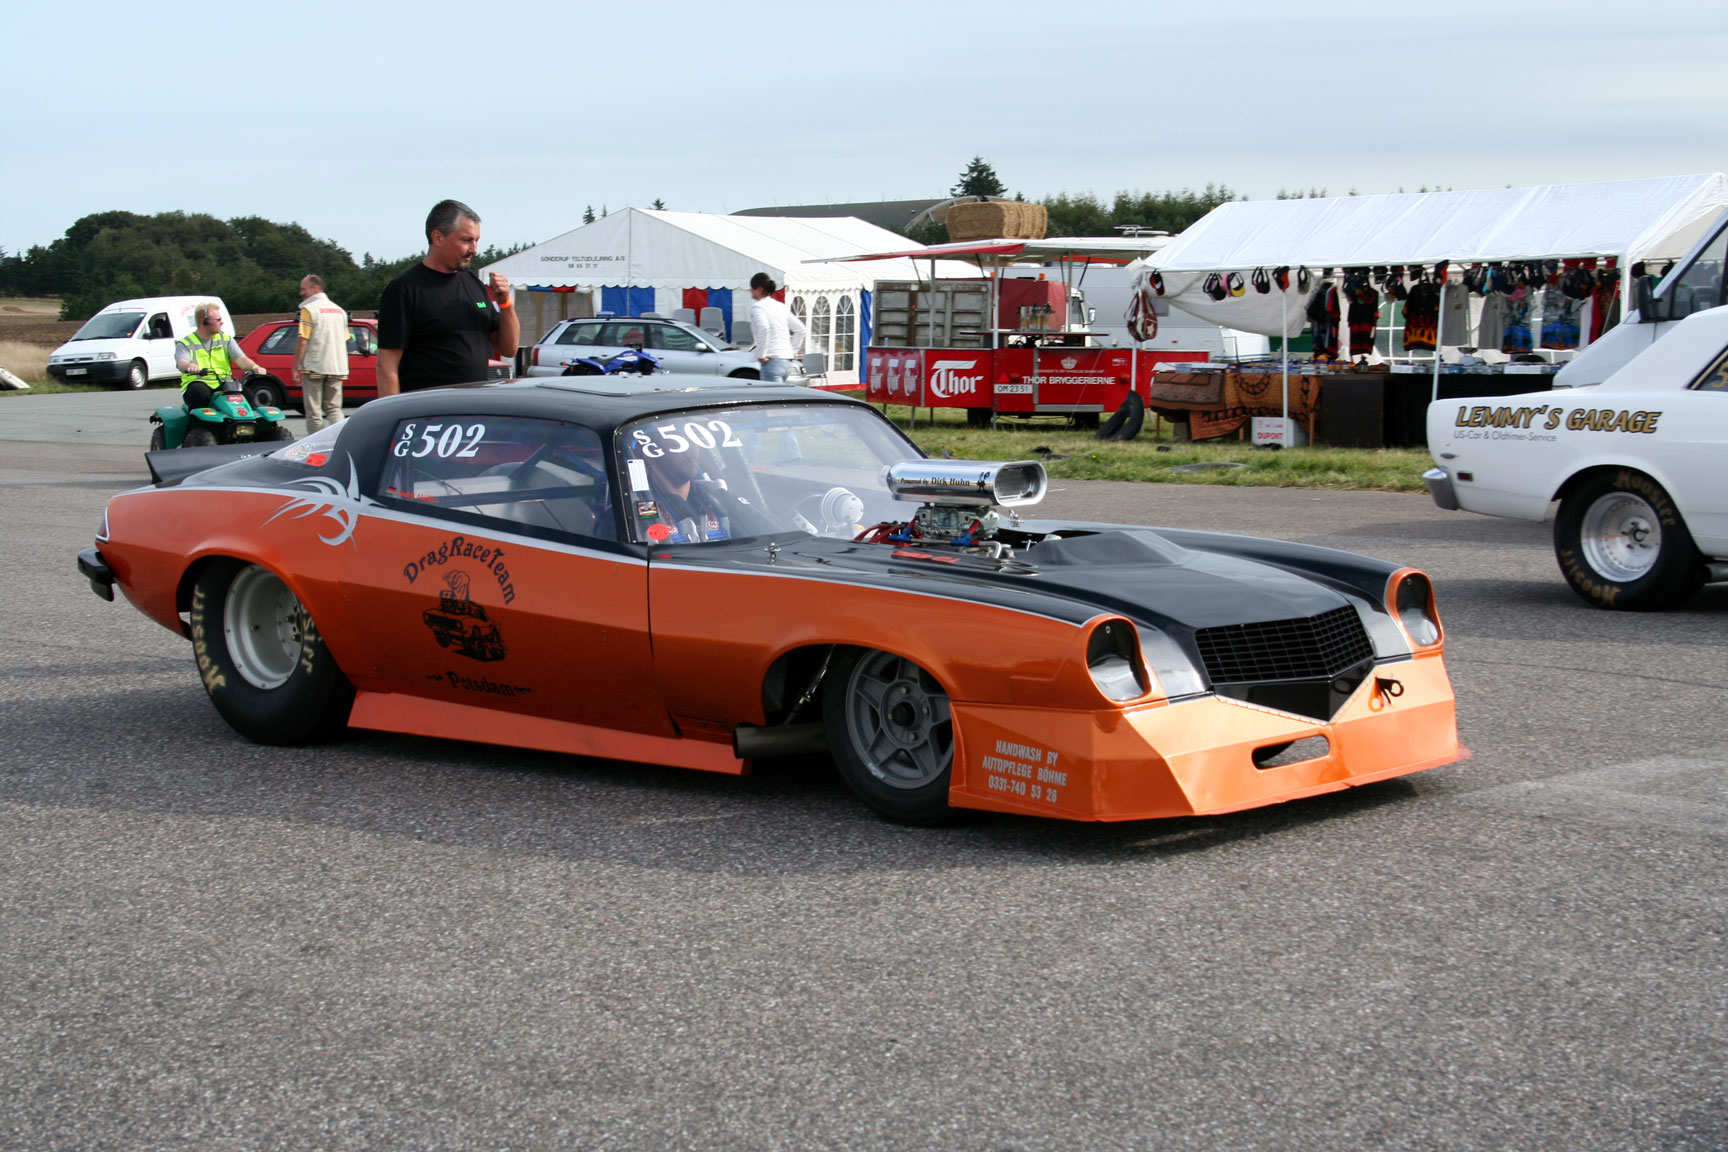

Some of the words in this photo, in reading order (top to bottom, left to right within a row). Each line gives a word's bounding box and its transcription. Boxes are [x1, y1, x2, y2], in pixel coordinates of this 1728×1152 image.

[930, 359, 985, 399] Thor
[1022, 376, 1047, 385] THOR
[1049, 376, 1116, 385] BRYGGERIERNE
[1455, 404, 1564, 431] LEMMY'S
[1566, 408, 1663, 434] GARAGE
[411, 423, 486, 458] 502
[657, 420, 744, 453] 502
[982, 756, 1032, 778] AUTOPFLEGE
[996, 740, 1041, 761] HANDWASH
[1047, 751, 1058, 766] BY
